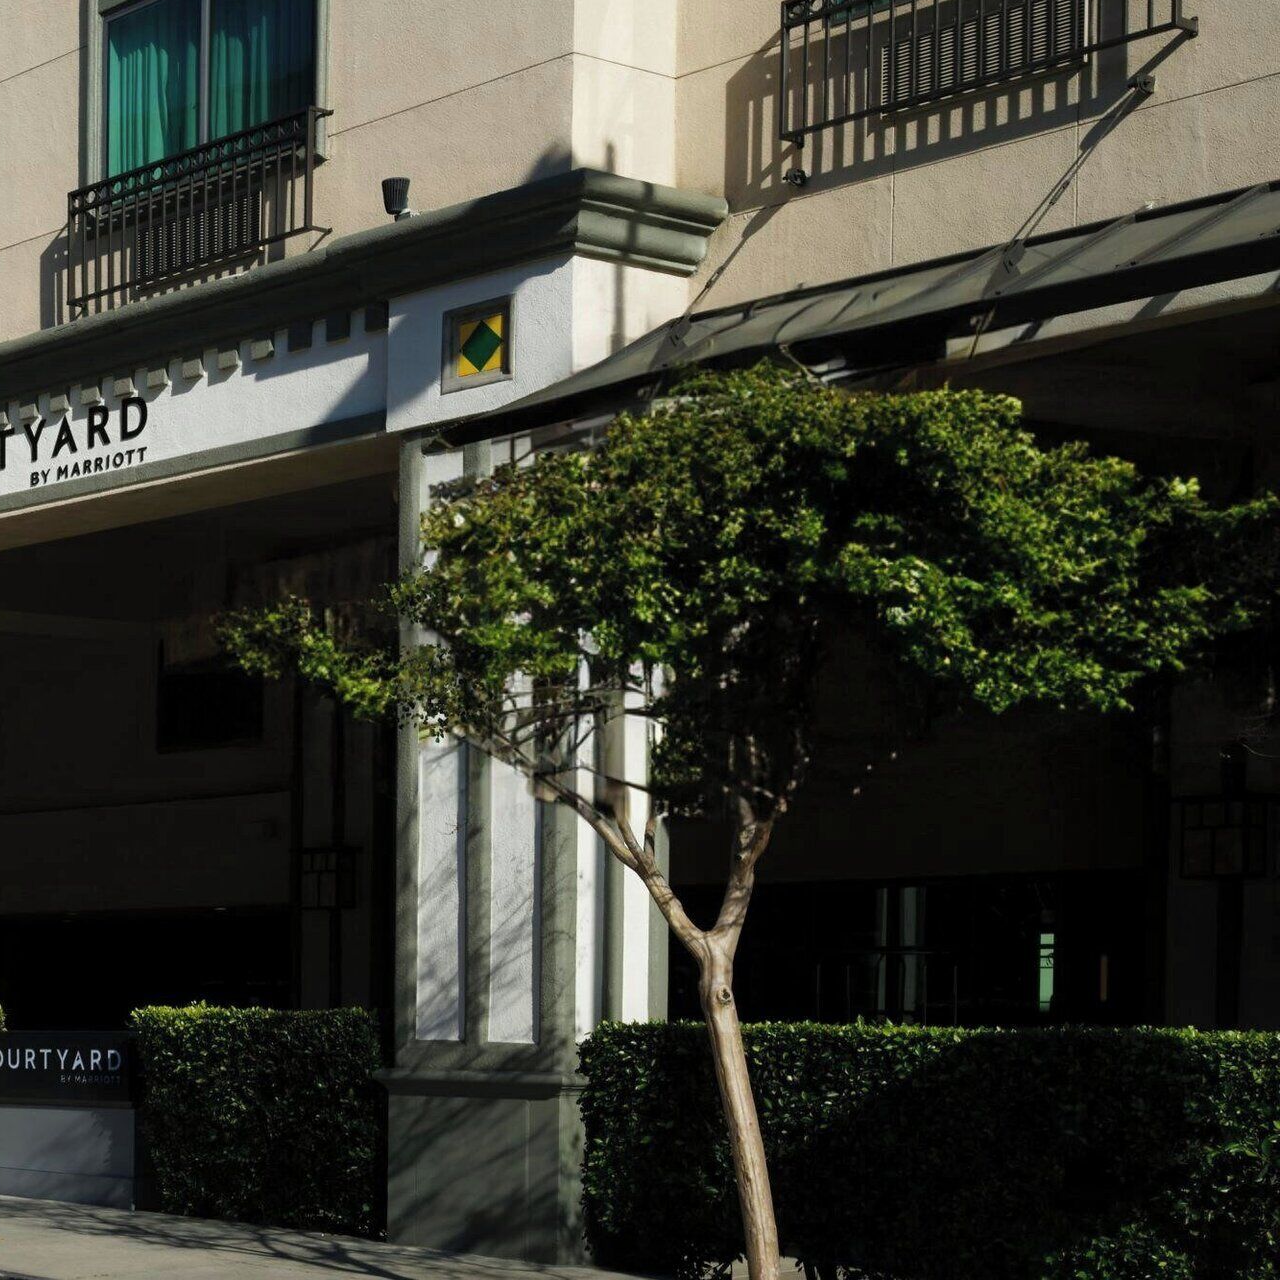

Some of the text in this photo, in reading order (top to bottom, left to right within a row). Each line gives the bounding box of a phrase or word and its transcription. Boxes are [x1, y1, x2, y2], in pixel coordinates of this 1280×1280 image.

[30, 447, 148, 487] BY MARRIOTT
[60, 1075, 121, 1084] BY MARRIOTT
